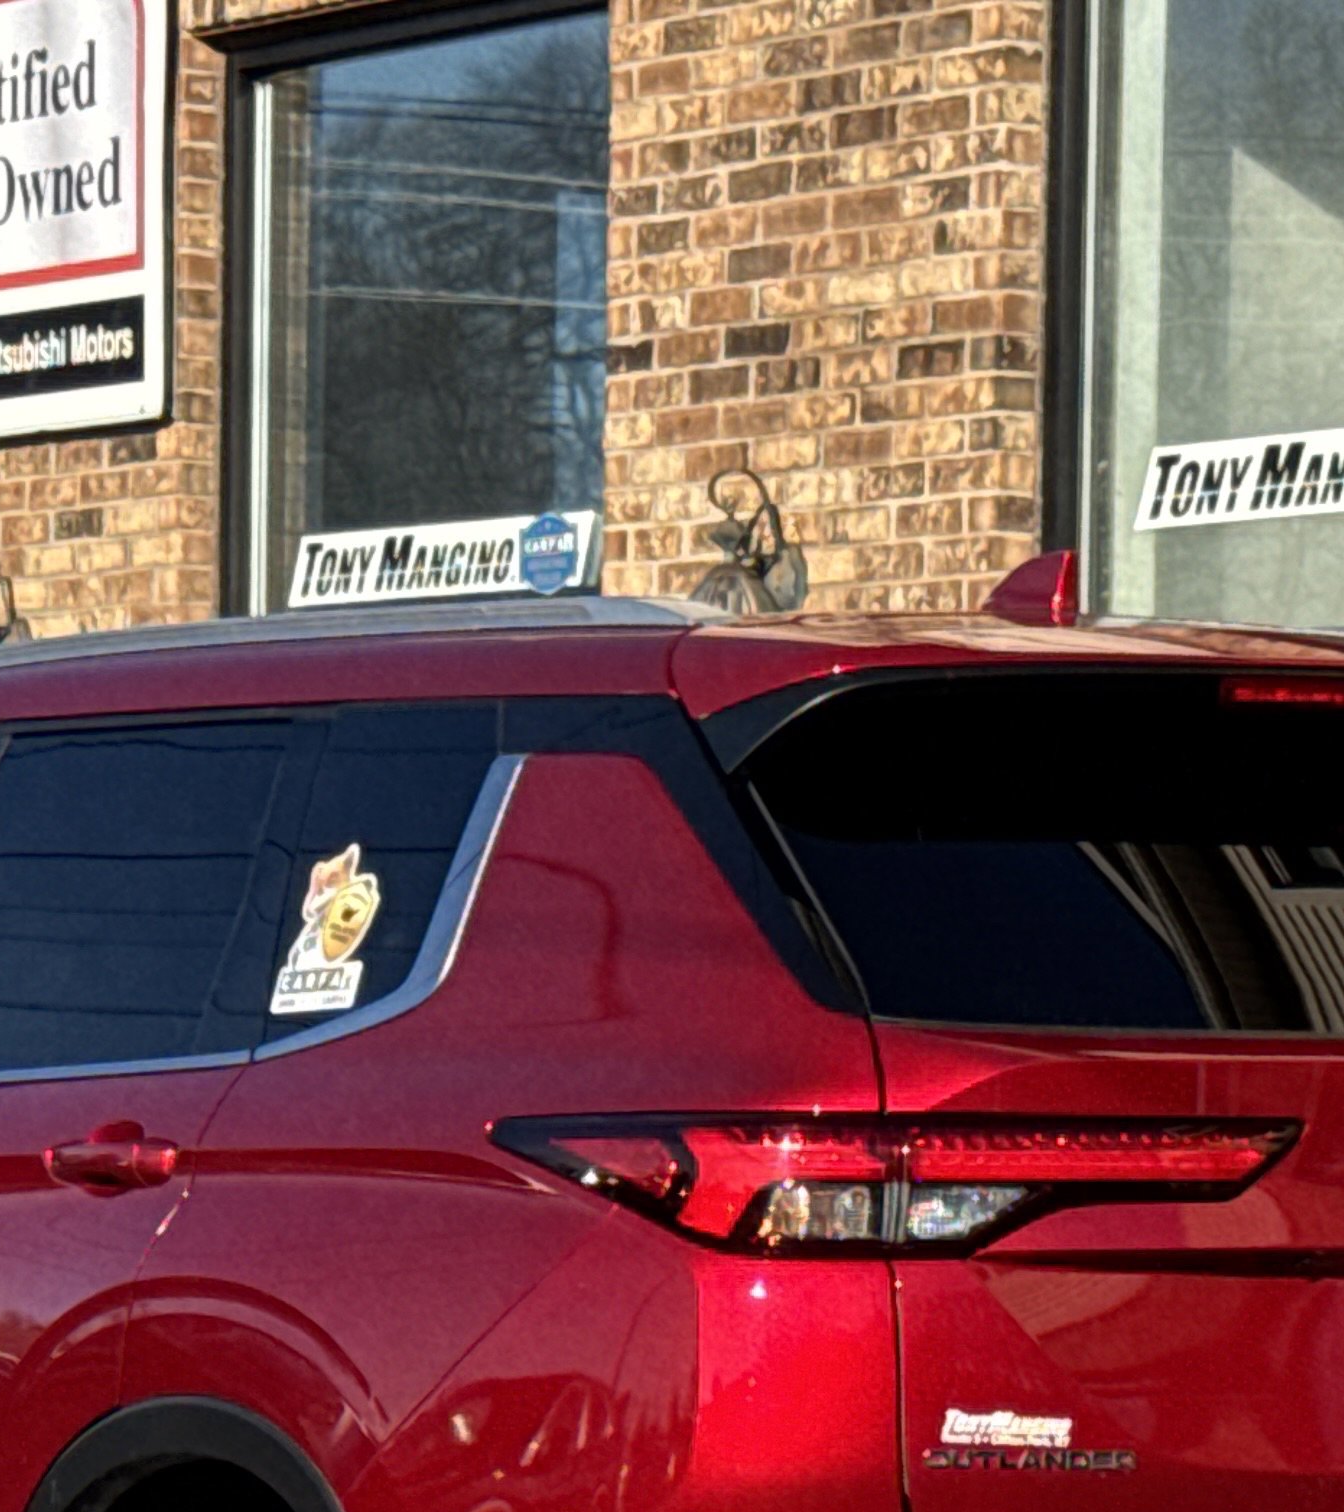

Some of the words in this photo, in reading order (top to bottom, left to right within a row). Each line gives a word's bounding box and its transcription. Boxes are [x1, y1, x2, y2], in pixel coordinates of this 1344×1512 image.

[70, 323, 134, 366] Motors
[1148, 453, 1254, 520] TONY
[301, 543, 375, 598] TONY
[375, 535, 514, 592] MANGINO
[924, 1450, 1136, 1470] OUTLANDER
